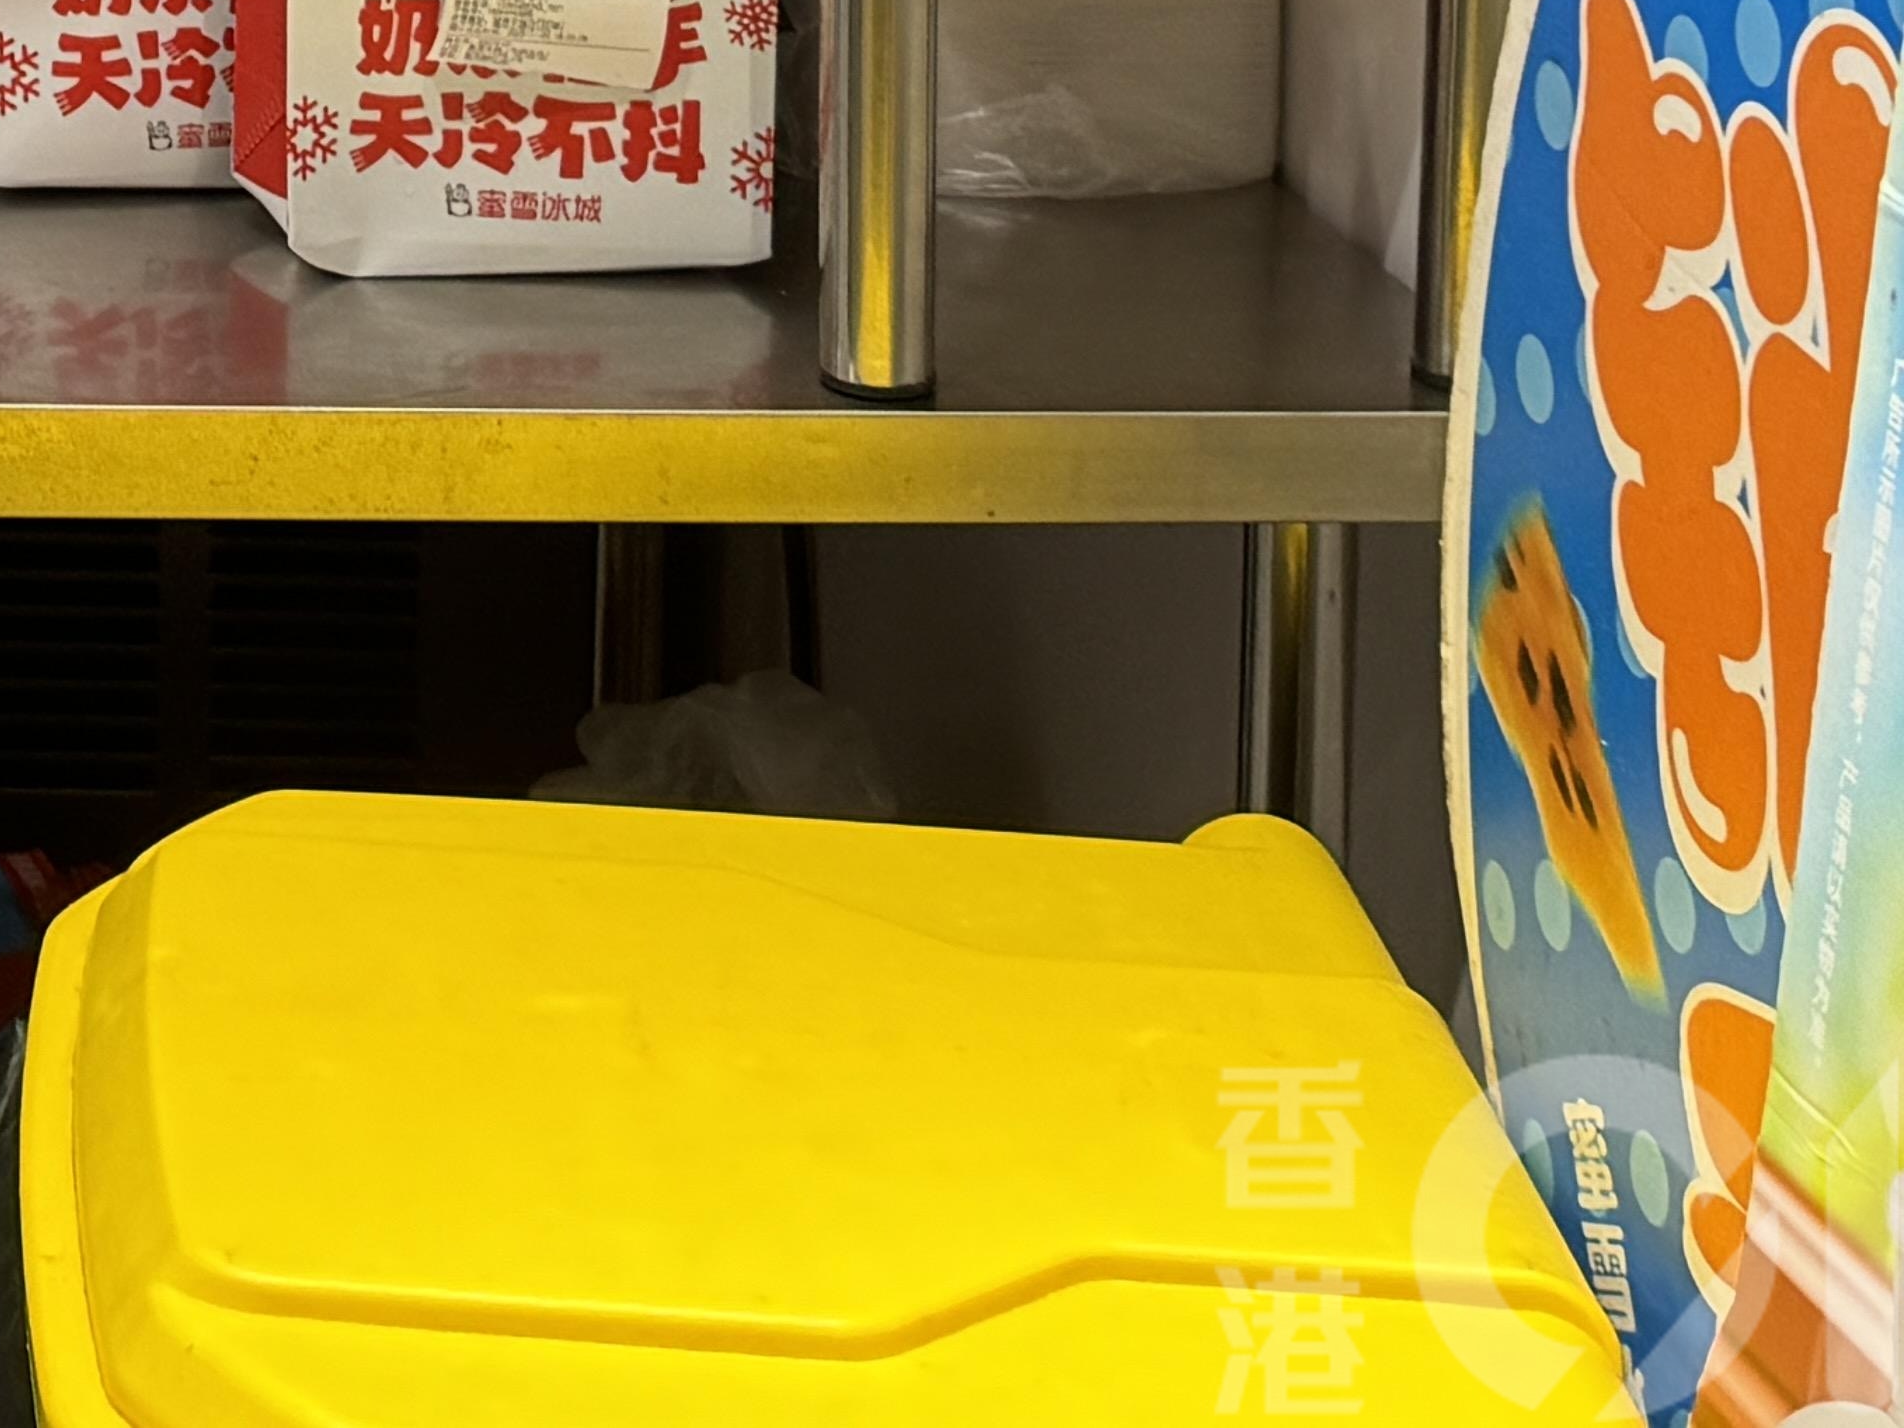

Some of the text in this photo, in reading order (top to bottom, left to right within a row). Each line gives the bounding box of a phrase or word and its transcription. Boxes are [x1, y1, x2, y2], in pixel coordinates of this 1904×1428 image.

[51, 27, 238, 117] 天冷
[349, 90, 707, 184] 天冷不抖
[475, 189, 603, 223] 蜜雪冰城
